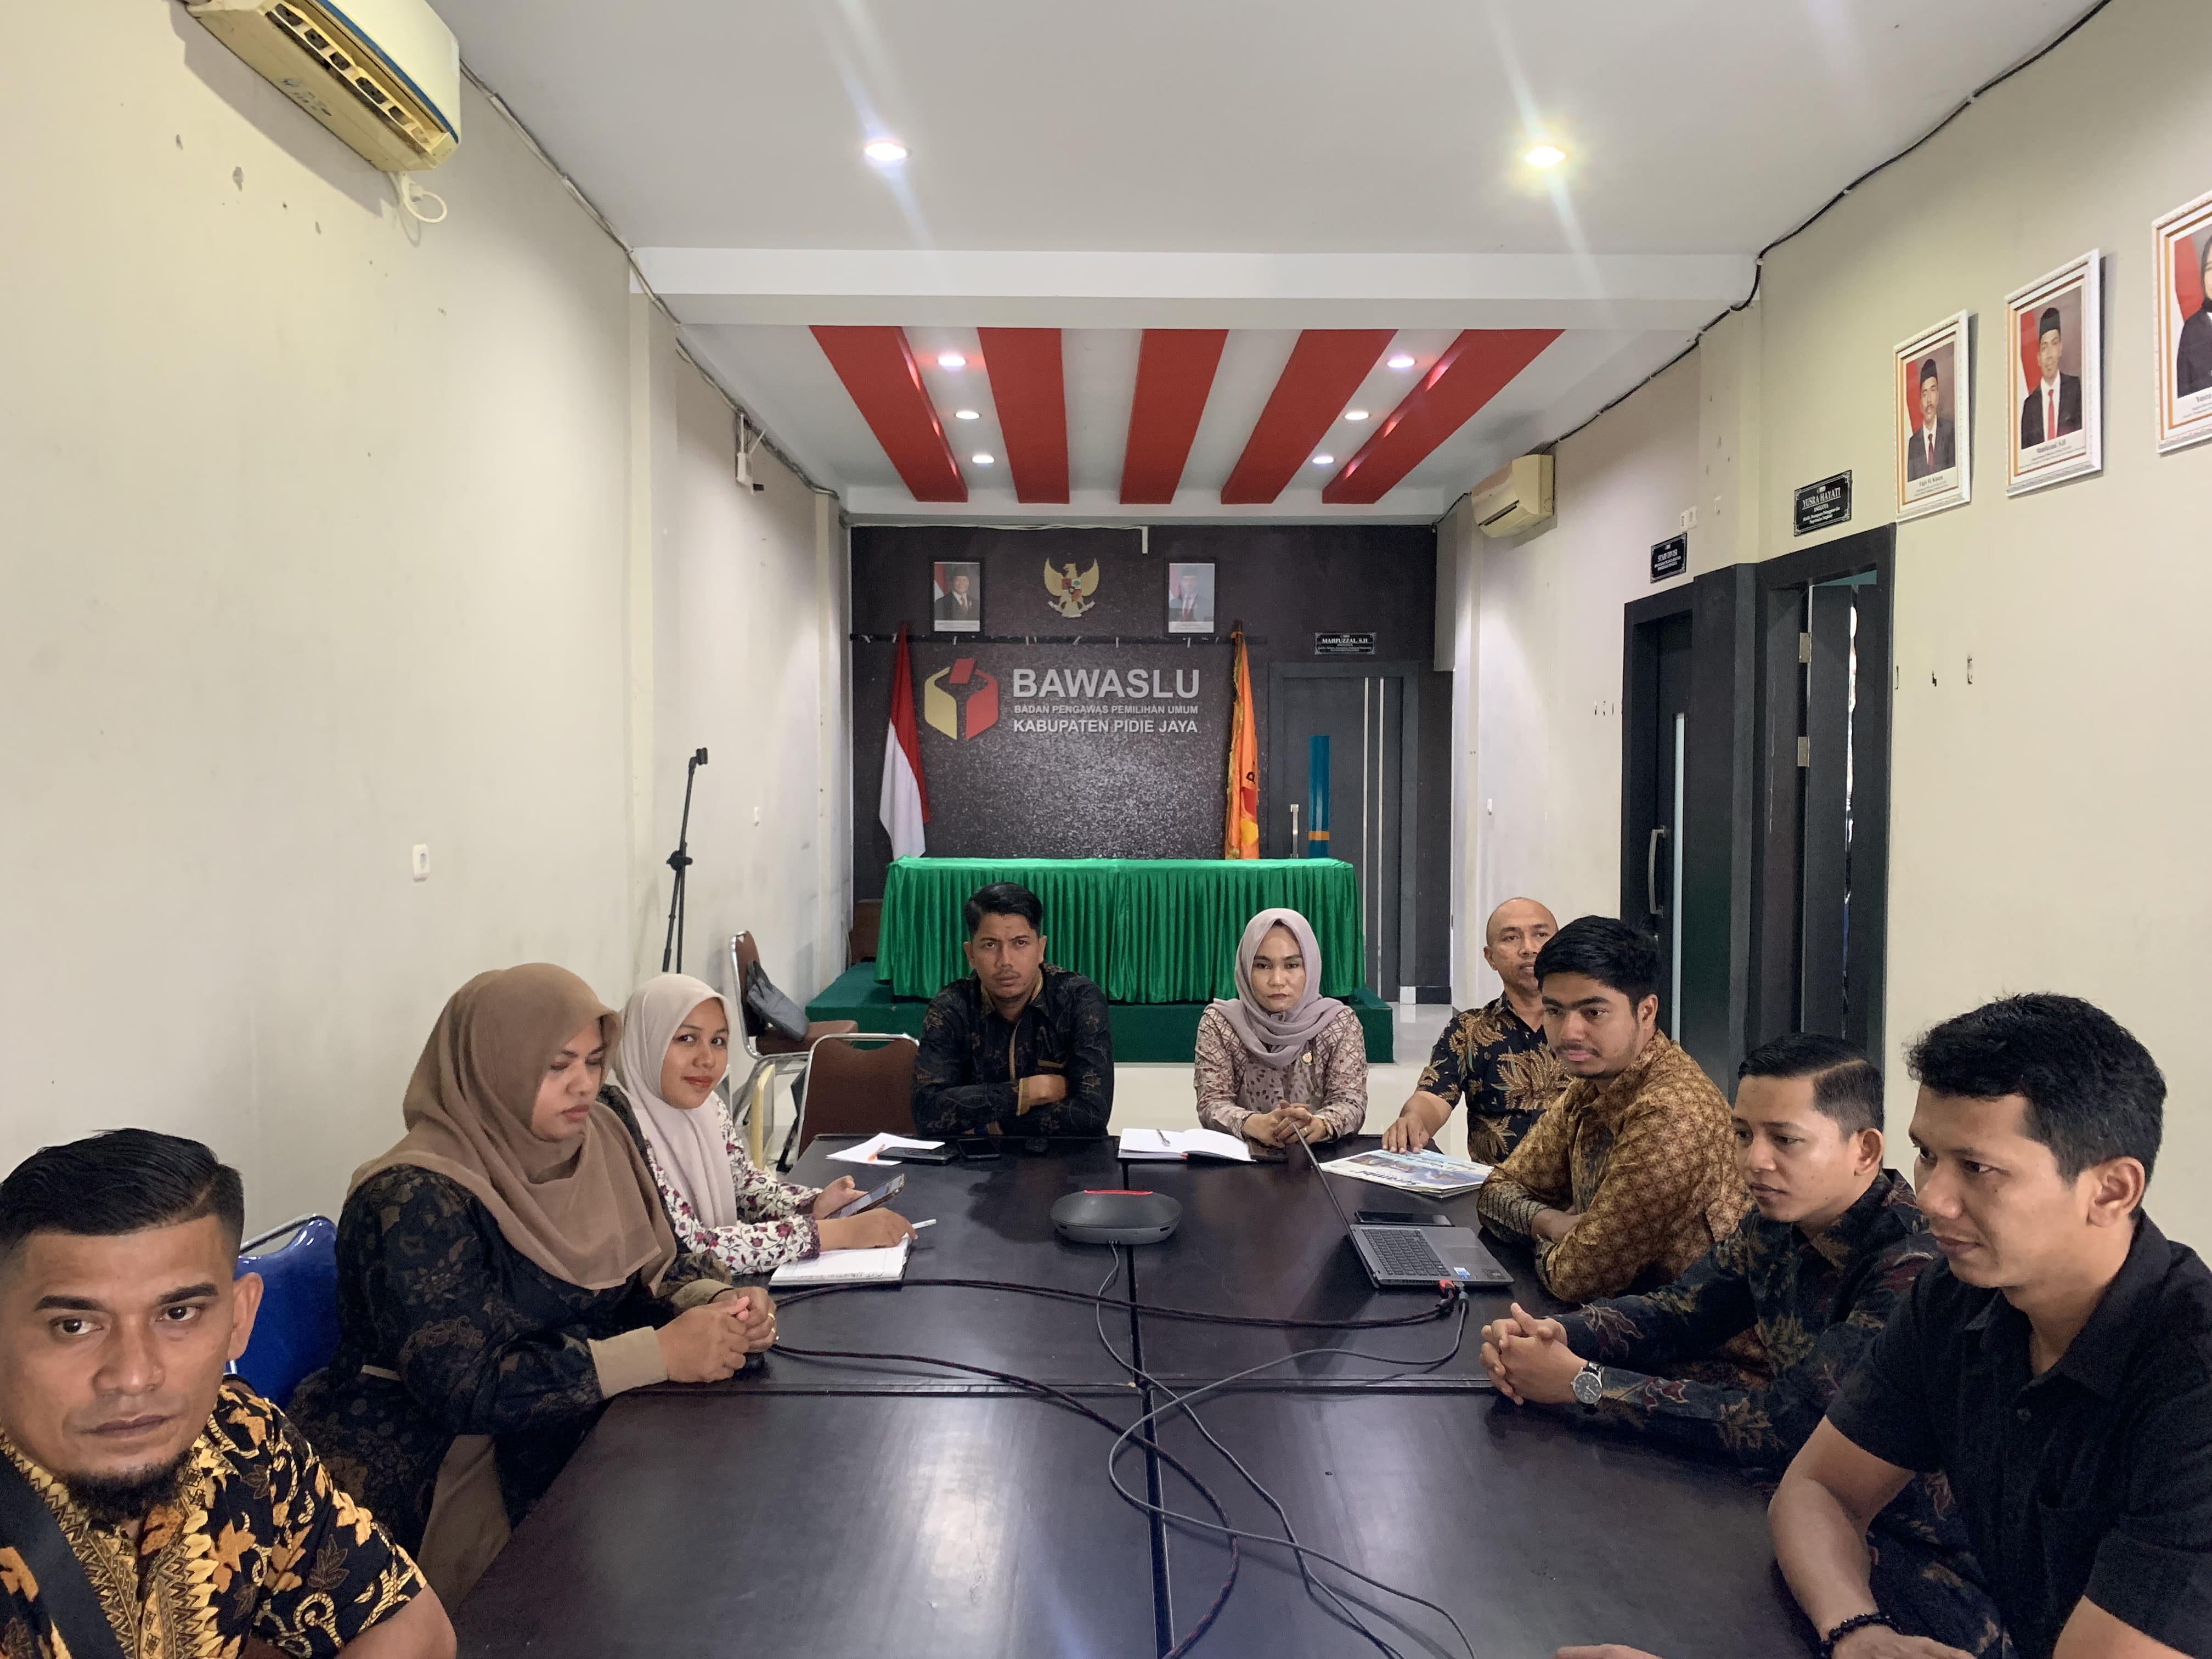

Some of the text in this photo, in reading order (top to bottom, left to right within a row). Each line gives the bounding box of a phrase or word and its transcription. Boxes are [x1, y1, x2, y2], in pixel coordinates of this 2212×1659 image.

[1803, 495, 1819, 507] YUSRA
[1820, 487, 1841, 501] HAYATI
[1013, 668, 1200, 698] BAWASLU
[1014, 705, 1198, 714] BADAN PENGAWAS PEMILIHAN UMUM
[1014, 719, 1198, 733] KABUPATEN PIDIE JAYA
